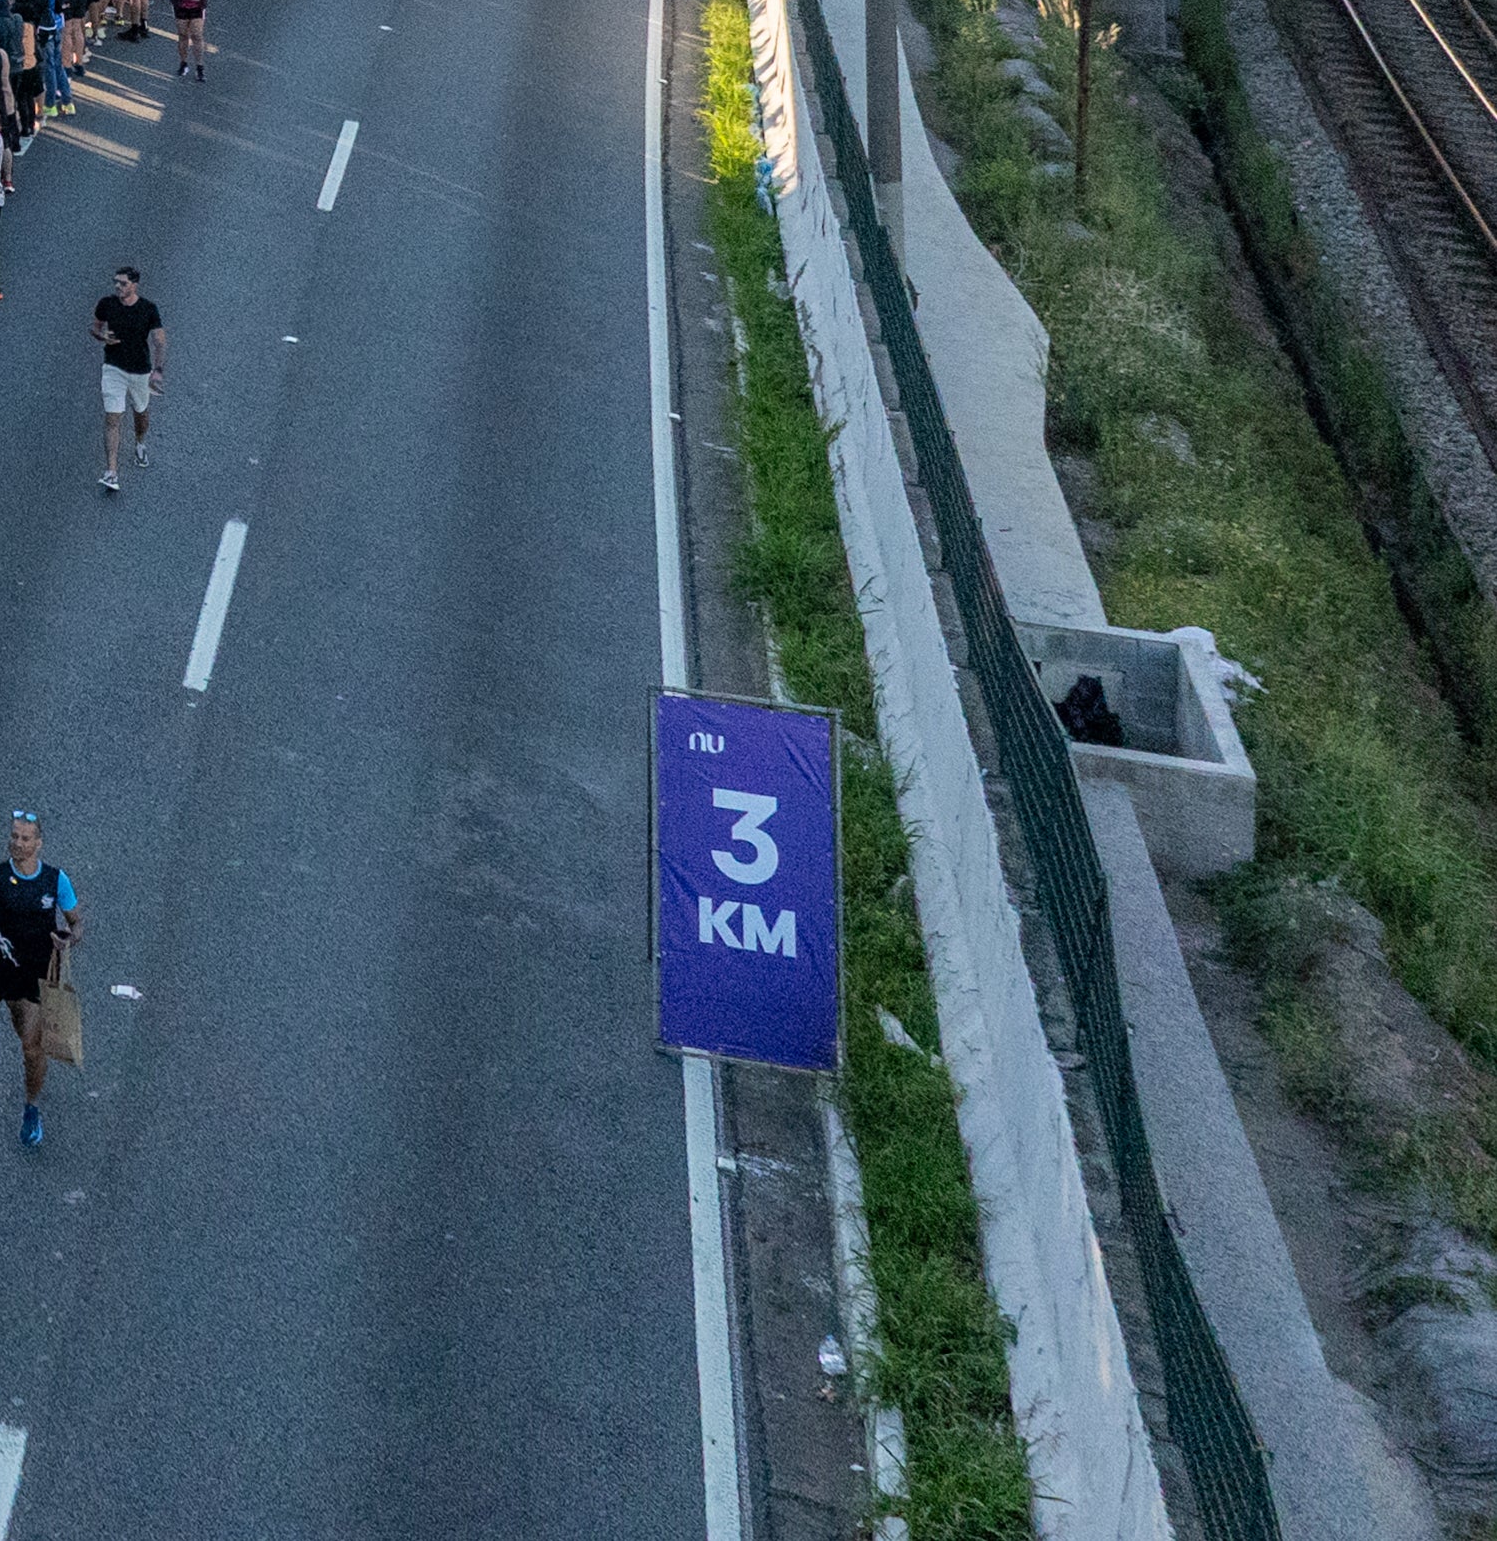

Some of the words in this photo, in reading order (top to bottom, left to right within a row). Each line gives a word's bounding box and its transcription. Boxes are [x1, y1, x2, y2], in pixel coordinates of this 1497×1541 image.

[688, 731, 725, 754] nu
[710, 787, 779, 885] 3
[698, 896, 797, 958] KM
